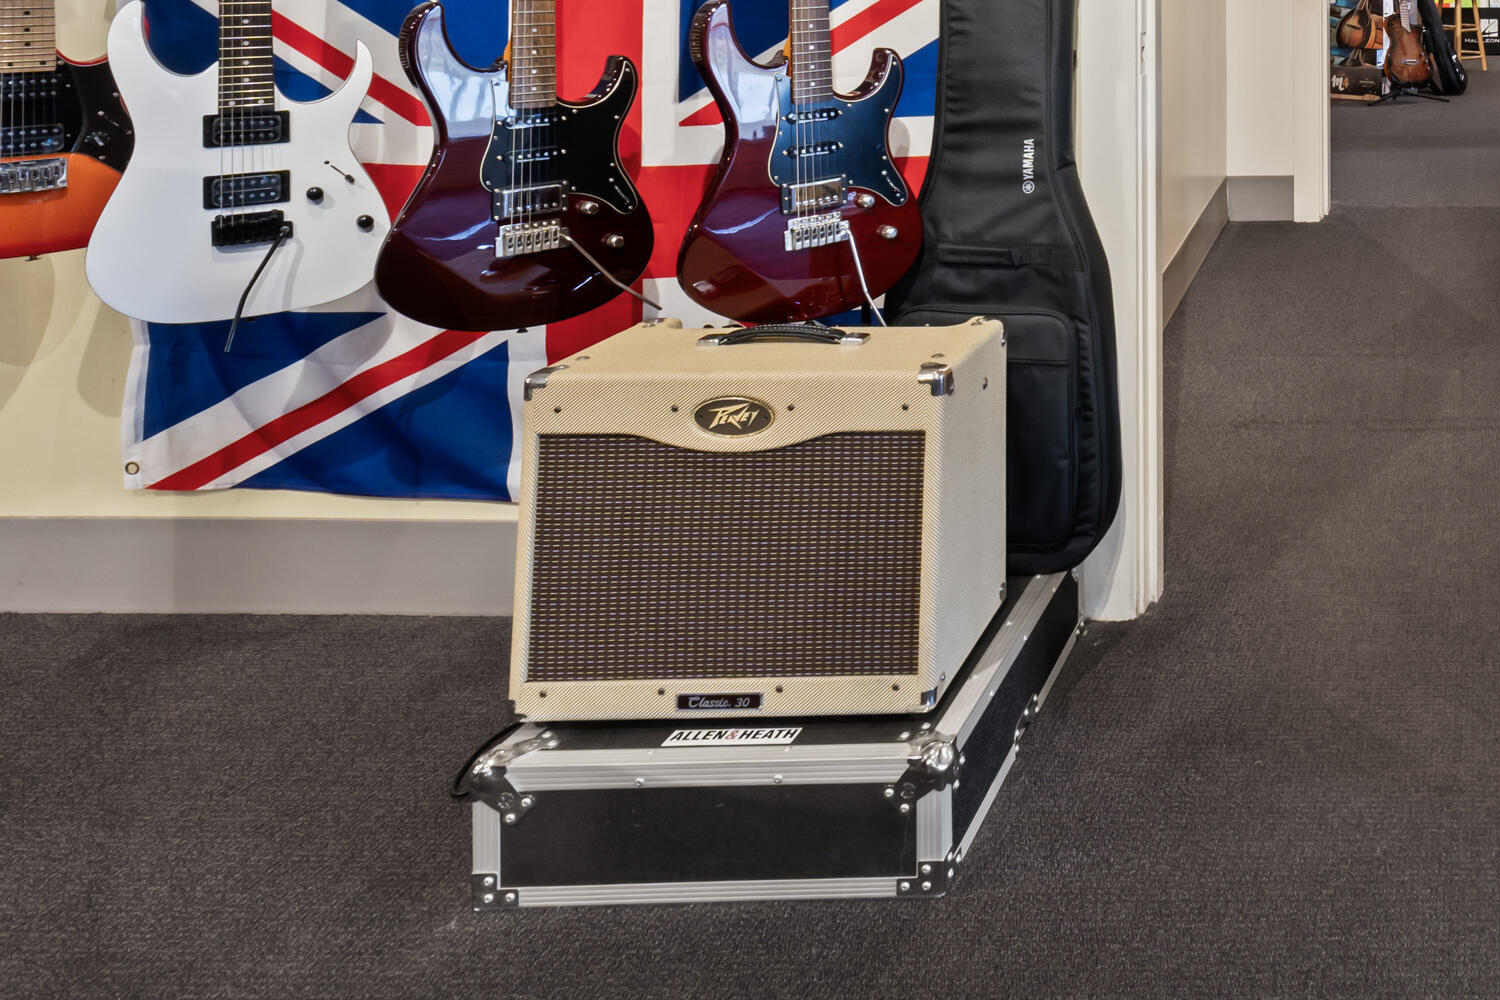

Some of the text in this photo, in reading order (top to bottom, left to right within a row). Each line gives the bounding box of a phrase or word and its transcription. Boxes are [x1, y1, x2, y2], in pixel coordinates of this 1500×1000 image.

[1022, 138, 1034, 180] YAMAHA
[707, 402, 761, 430] PEAVEY
[735, 697, 750, 708] 30
